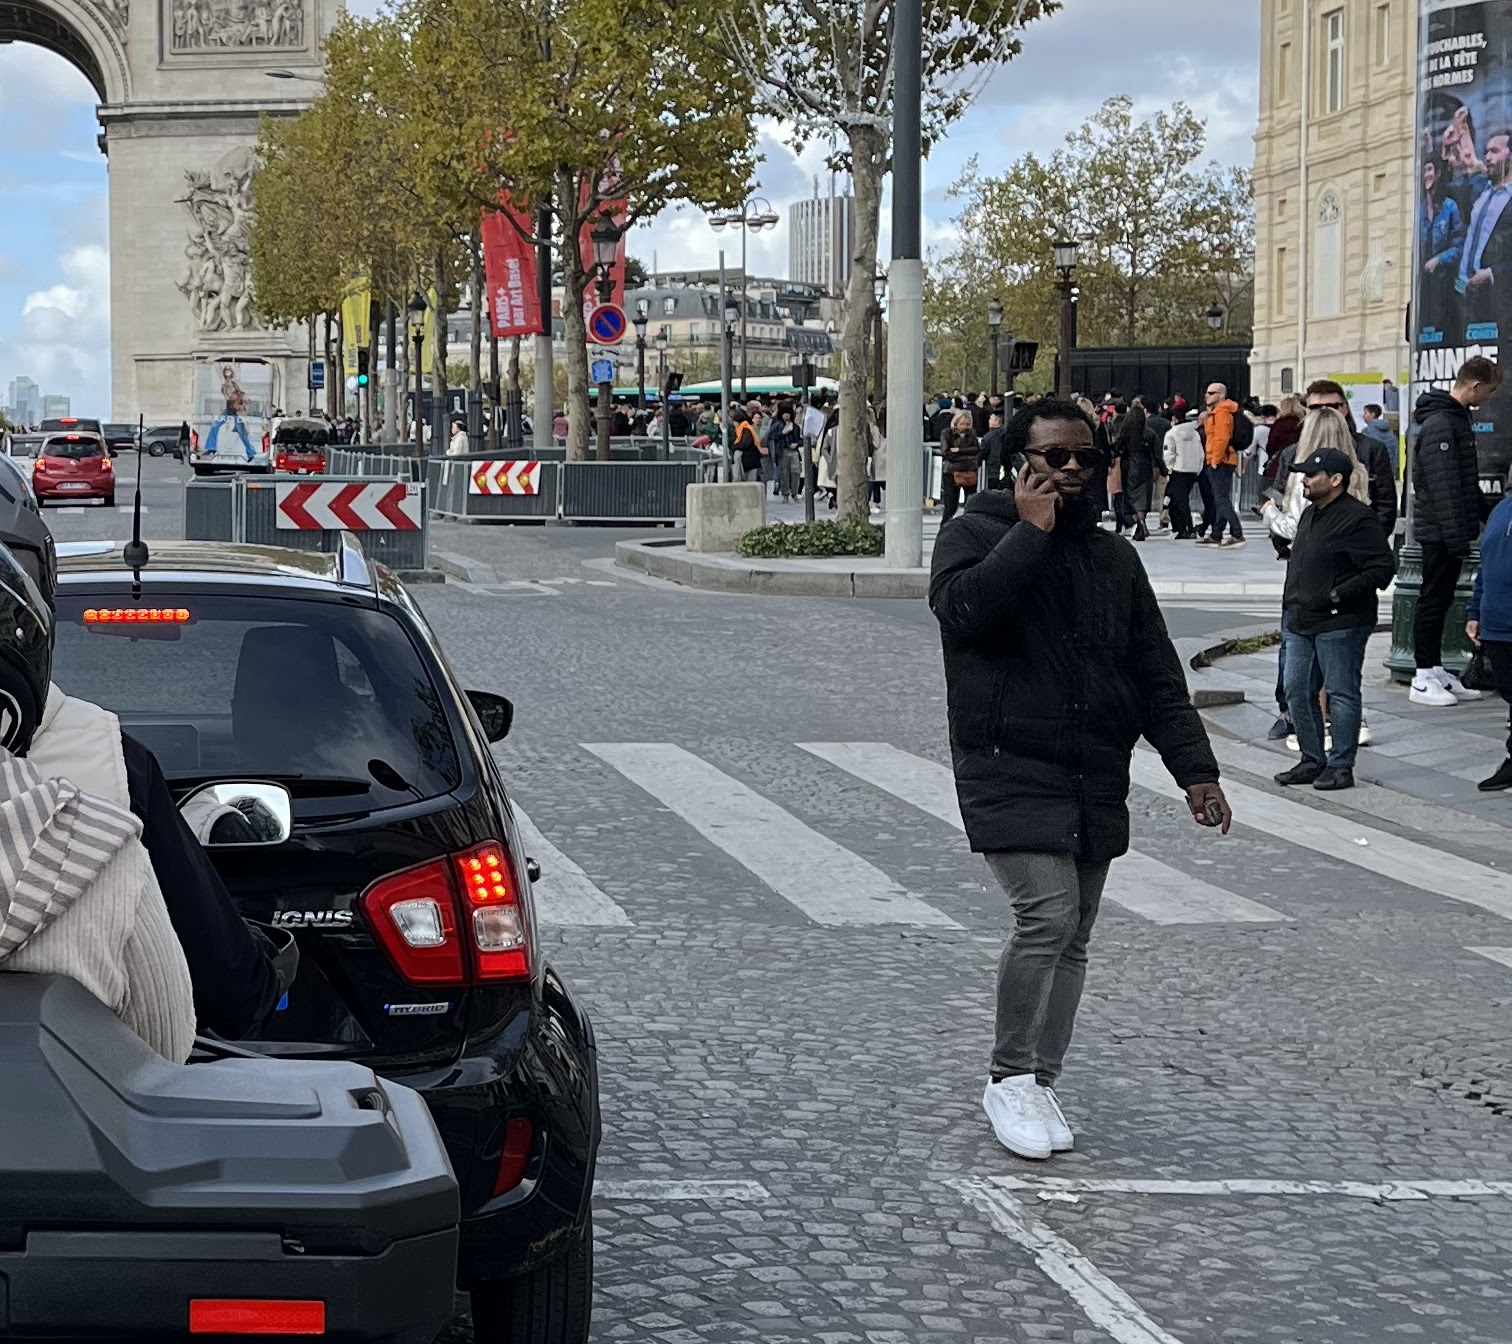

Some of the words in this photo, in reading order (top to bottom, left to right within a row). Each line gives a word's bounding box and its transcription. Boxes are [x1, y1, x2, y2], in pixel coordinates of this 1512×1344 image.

[1439, 55, 1452, 70] LA
[1453, 49, 1478, 68] FÊTE
[271, 910, 354, 929] IGNIS
